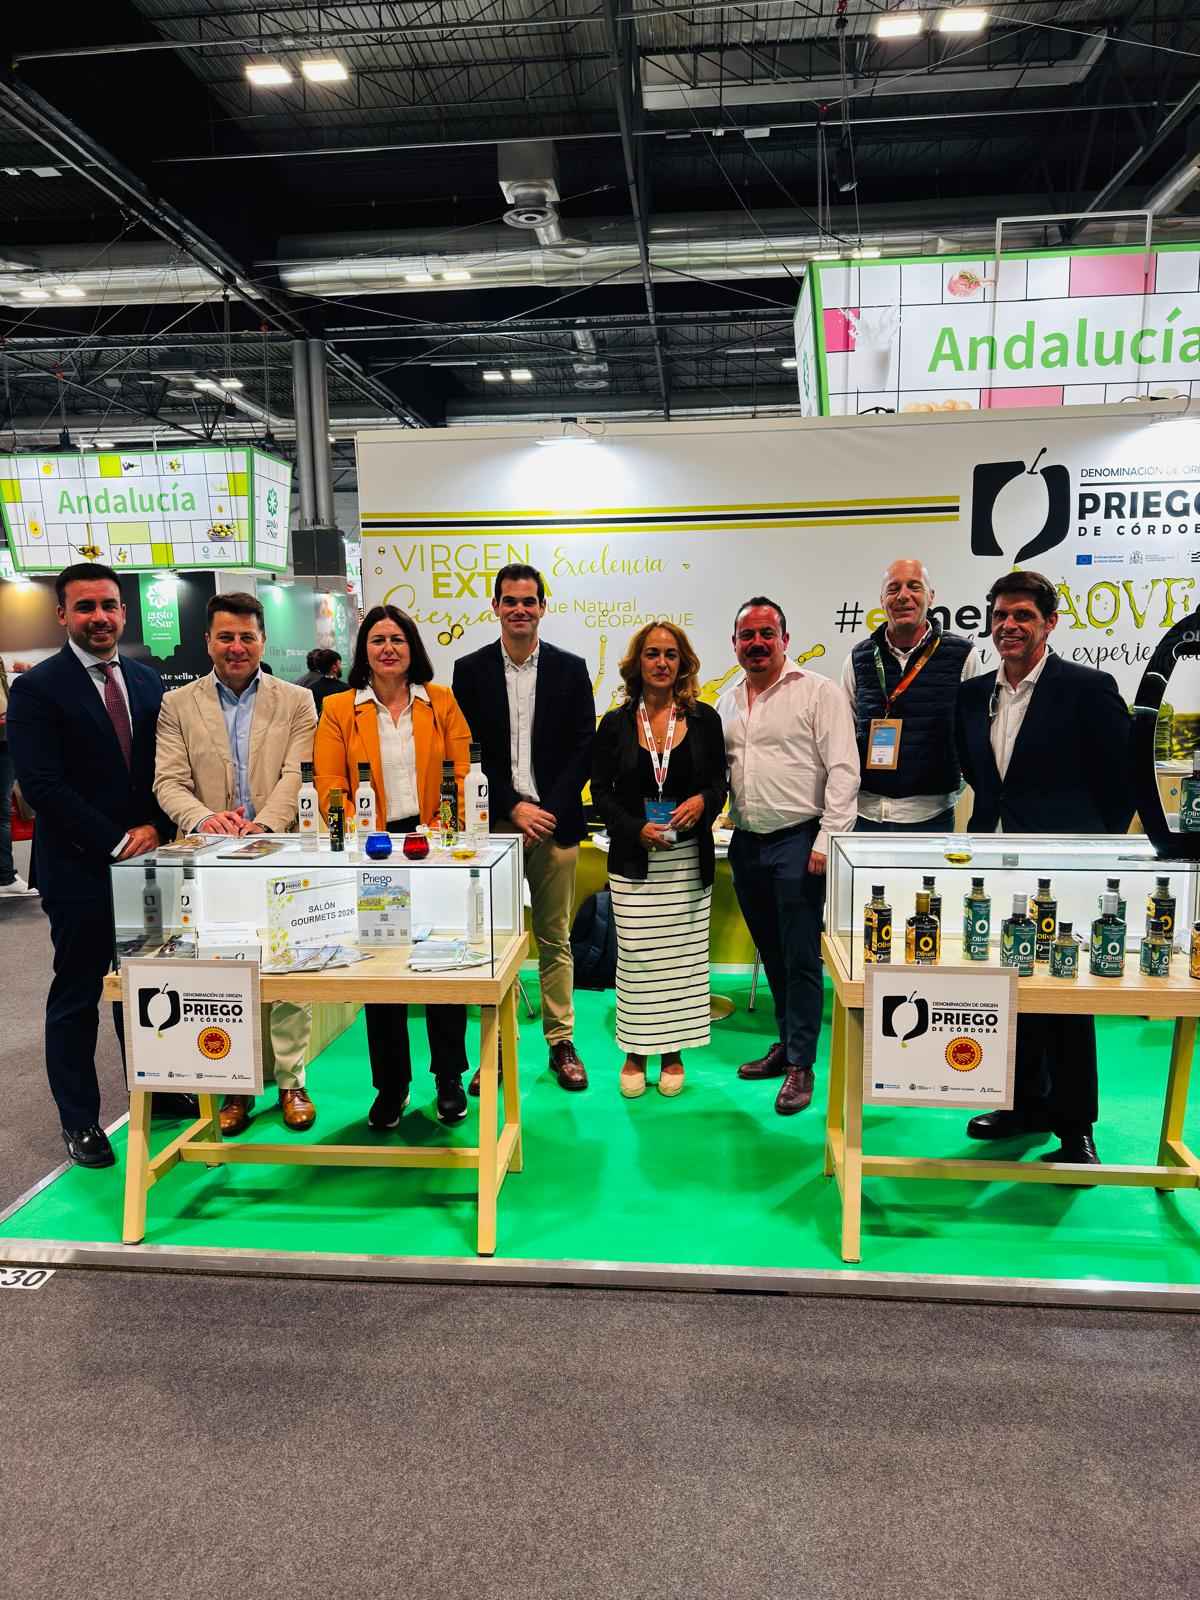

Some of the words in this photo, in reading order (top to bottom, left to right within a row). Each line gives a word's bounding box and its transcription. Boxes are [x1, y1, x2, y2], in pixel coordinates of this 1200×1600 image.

[927, 306, 1200, 373] Andalucía
[58, 482, 197, 514] Andalucía
[1078, 490, 1200, 520] PRIEG
[1078, 527, 1101, 536] DE
[392, 543, 530, 573] VIRGEN
[552, 544, 667, 577] Excelencia
[573, 598, 637, 614] Natural
[362, 872, 393, 887] Priego
[308, 902, 336, 914] SALÓN
[290, 909, 336, 928] GOURMETS
[183, 1003, 243, 1016] PRIEGO
[931, 1012, 998, 1026] PRIEGO
